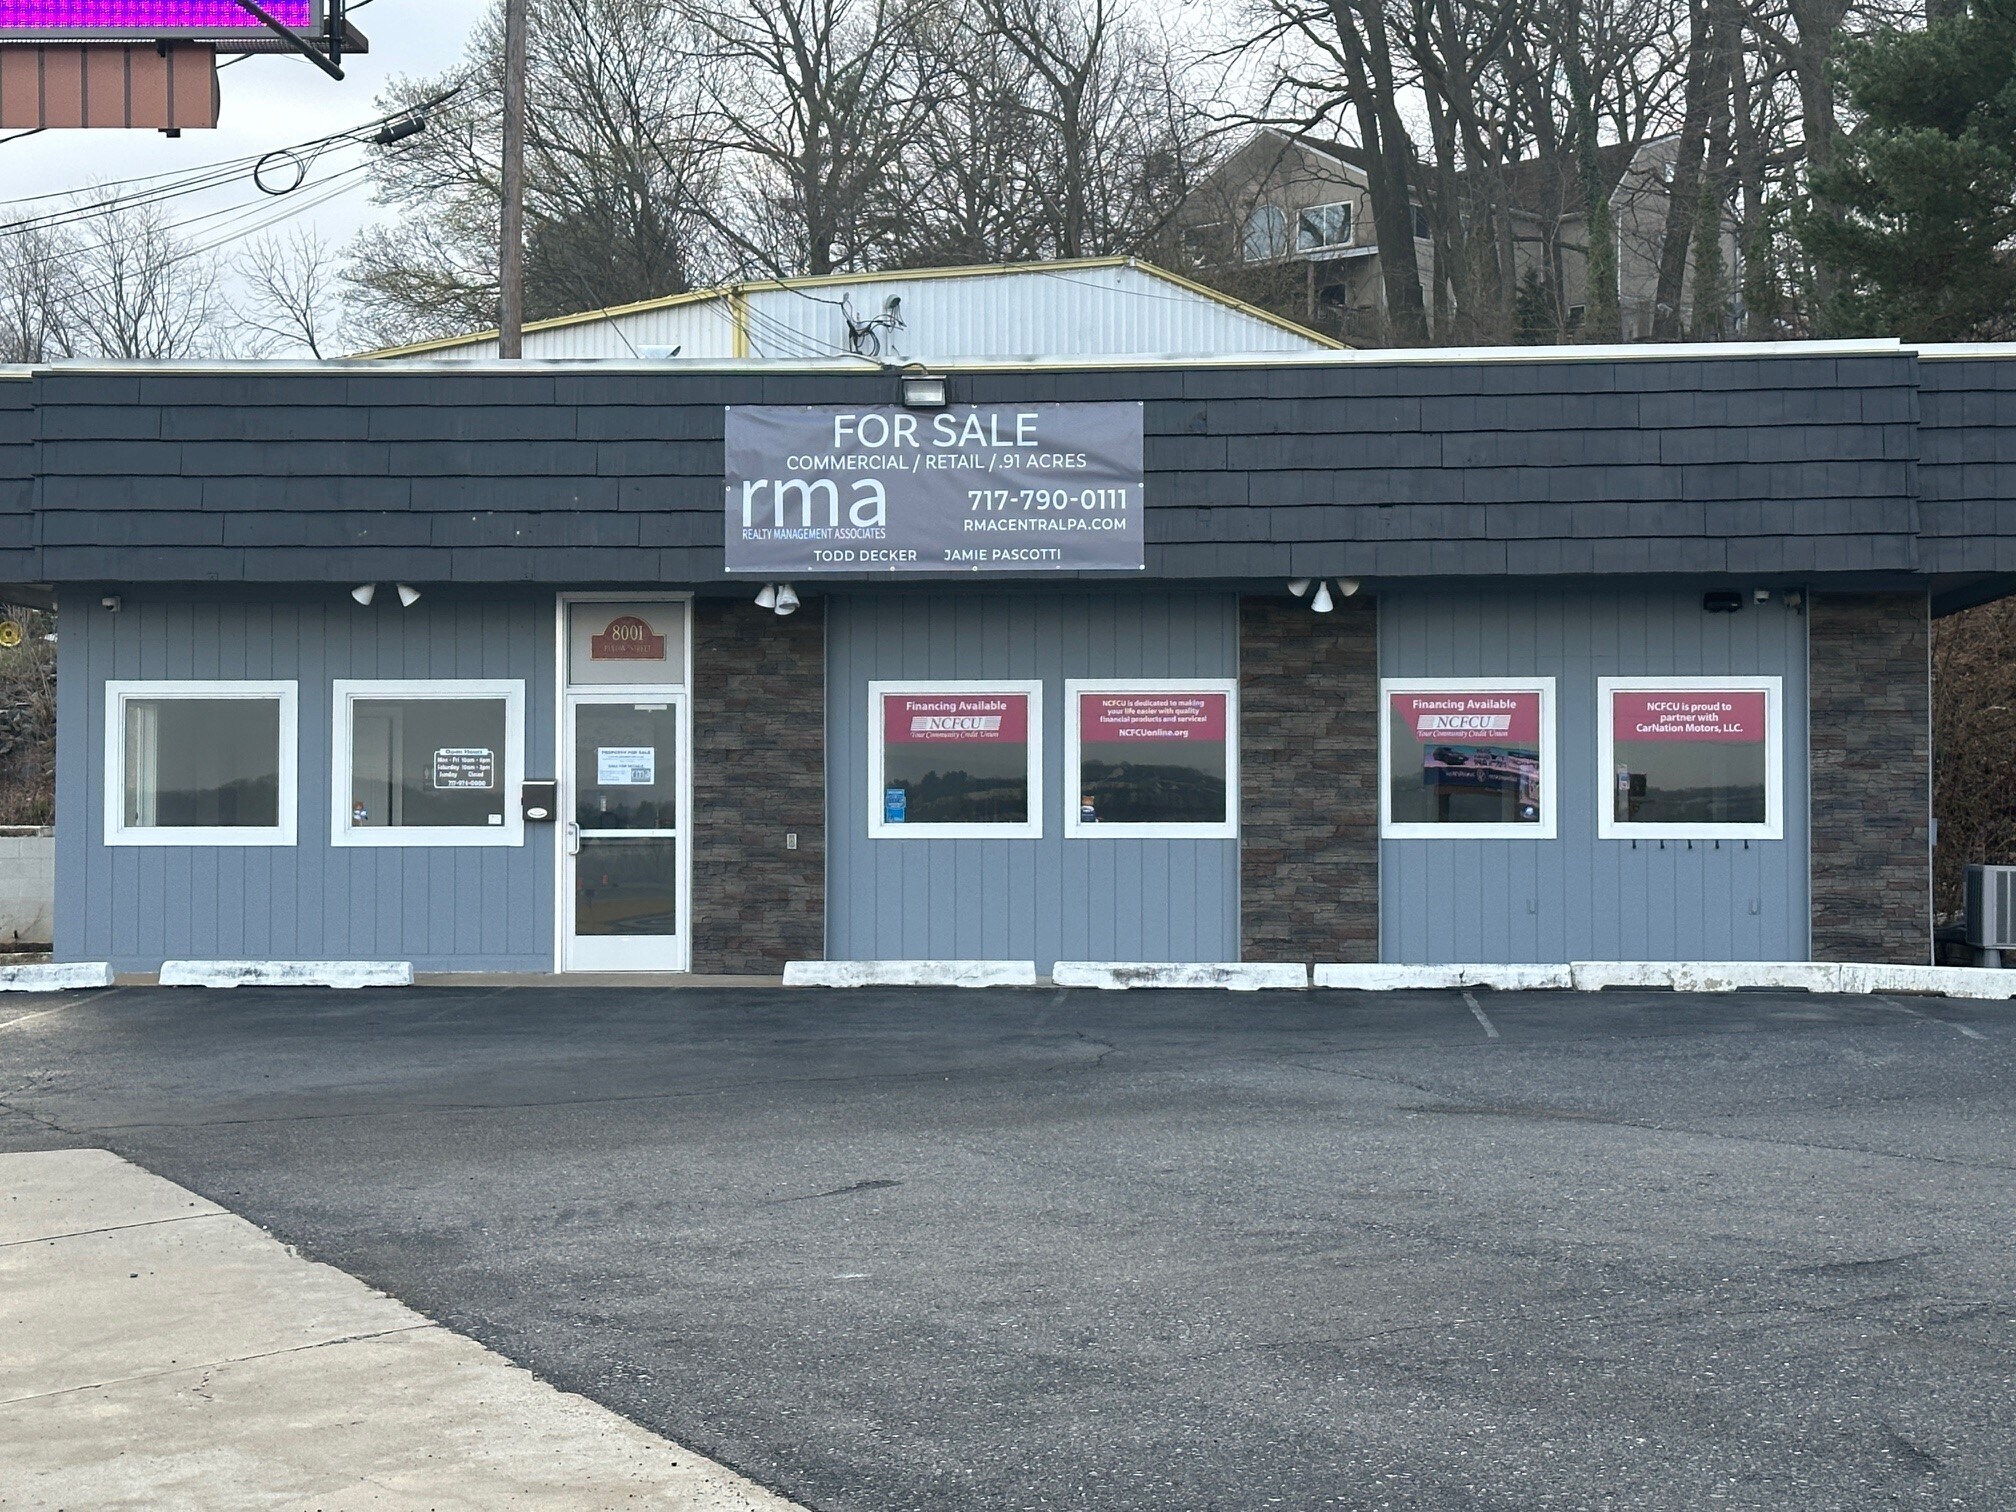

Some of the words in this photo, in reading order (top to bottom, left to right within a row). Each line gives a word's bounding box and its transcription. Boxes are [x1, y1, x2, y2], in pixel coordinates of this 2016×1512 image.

[834, 413, 920, 448] FOR
[932, 413, 1039, 447] SALE
[786, 455, 909, 470] COMMERCIAL
[926, 454, 985, 470] RETAIL
[1026, 453, 1087, 469] ACRES
[742, 477, 886, 527] rma
[968, 489, 1126, 510] 717-790-0111
[963, 518, 1126, 531] RMACENTRALPA.COM
[742, 528, 772, 540] REALTY
[773, 528, 833, 540] MANAGEMENT
[834, 528, 886, 539] ASSOCIATES
[814, 550, 855, 562] TODD
[859, 550, 917, 561] DECKER
[944, 549, 988, 561] JAMIE
[992, 549, 1061, 560] PASCOTTI
[612, 624, 643, 641] 8001
[906, 701, 957, 713] Financing
[958, 700, 1007, 711] Available
[1127, 699, 1134, 707] is
[1134, 699, 1168, 707] dedicated
[1169, 699, 1178, 707] to
[1178, 699, 1205, 708] making
[1412, 699, 1465, 711] Financing
[1466, 699, 1517, 709] Available
[1646, 702, 1680, 711] NCFCU
[1681, 702, 1689, 711] is
[1691, 702, 1720, 713] proud
[1721, 703, 1732, 711] to
[1107, 708, 1123, 716] your
[1174, 707, 1200, 716] quality
[1660, 714, 1696, 723] partner
[1697, 712, 1719, 722] with
[929, 717, 984, 730] NCFCU
[1099, 715, 1131, 723] financial
[1131, 715, 1162, 724] products
[1162, 715, 1177, 723] and
[1436, 716, 1491, 729] NCFCU
[1119, 728, 1189, 738] NCFCUonline.org
[1432, 730, 1467, 739] Community
[1468, 730, 1487, 738] Credit
[1635, 723, 1684, 733] CarNation
[1685, 723, 1722, 734] Motors,
[1723, 723, 1743, 733] LLC.
[925, 731, 960, 739] Community
